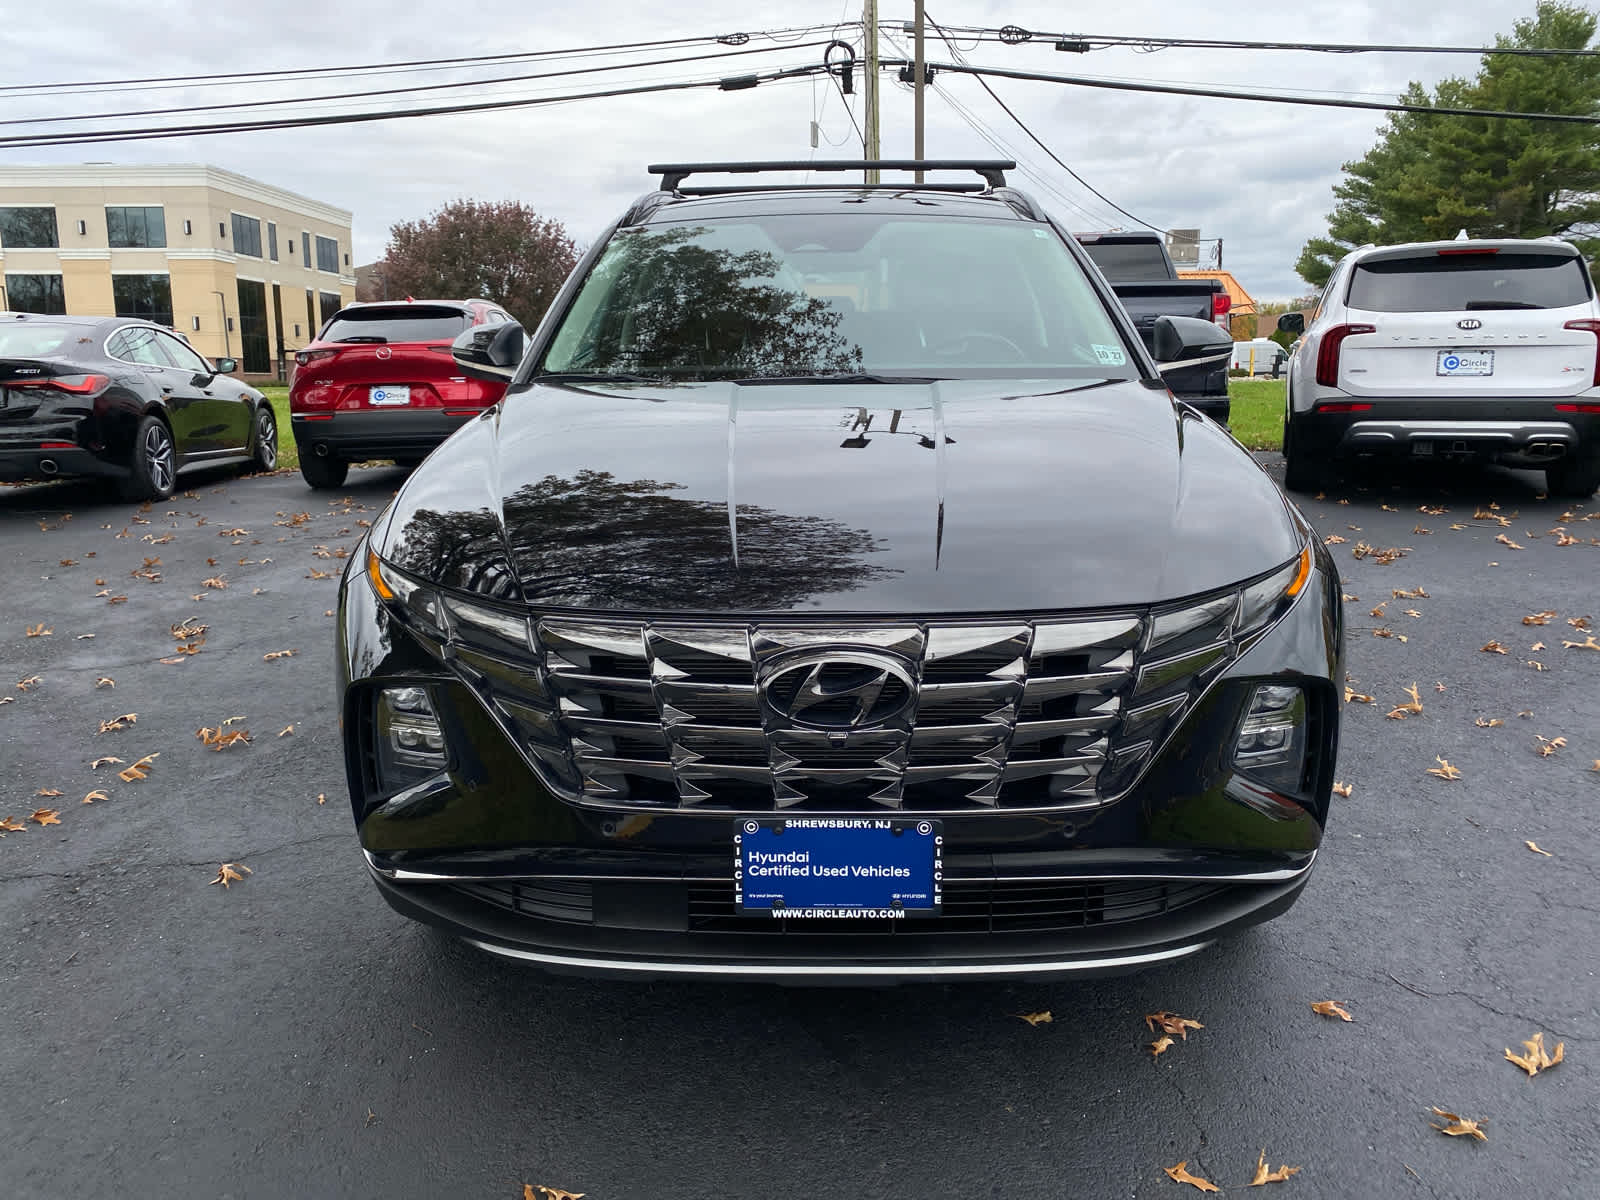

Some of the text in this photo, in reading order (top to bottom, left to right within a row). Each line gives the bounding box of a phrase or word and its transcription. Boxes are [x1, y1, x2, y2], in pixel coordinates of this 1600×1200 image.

[1460, 320, 1480, 328] KIA
[1460, 358, 1488, 367] Circle
[785, 819, 891, 829] SHREWSBURY, NJ
[748, 851, 809, 865] Hyundai
[734, 834, 743, 904] CIRCLE
[748, 864, 911, 877] Certified Used Vehicles
[934, 835, 943, 905] CIRCLE
[772, 909, 905, 919] WWW.CIRCLEAUTO.COM
